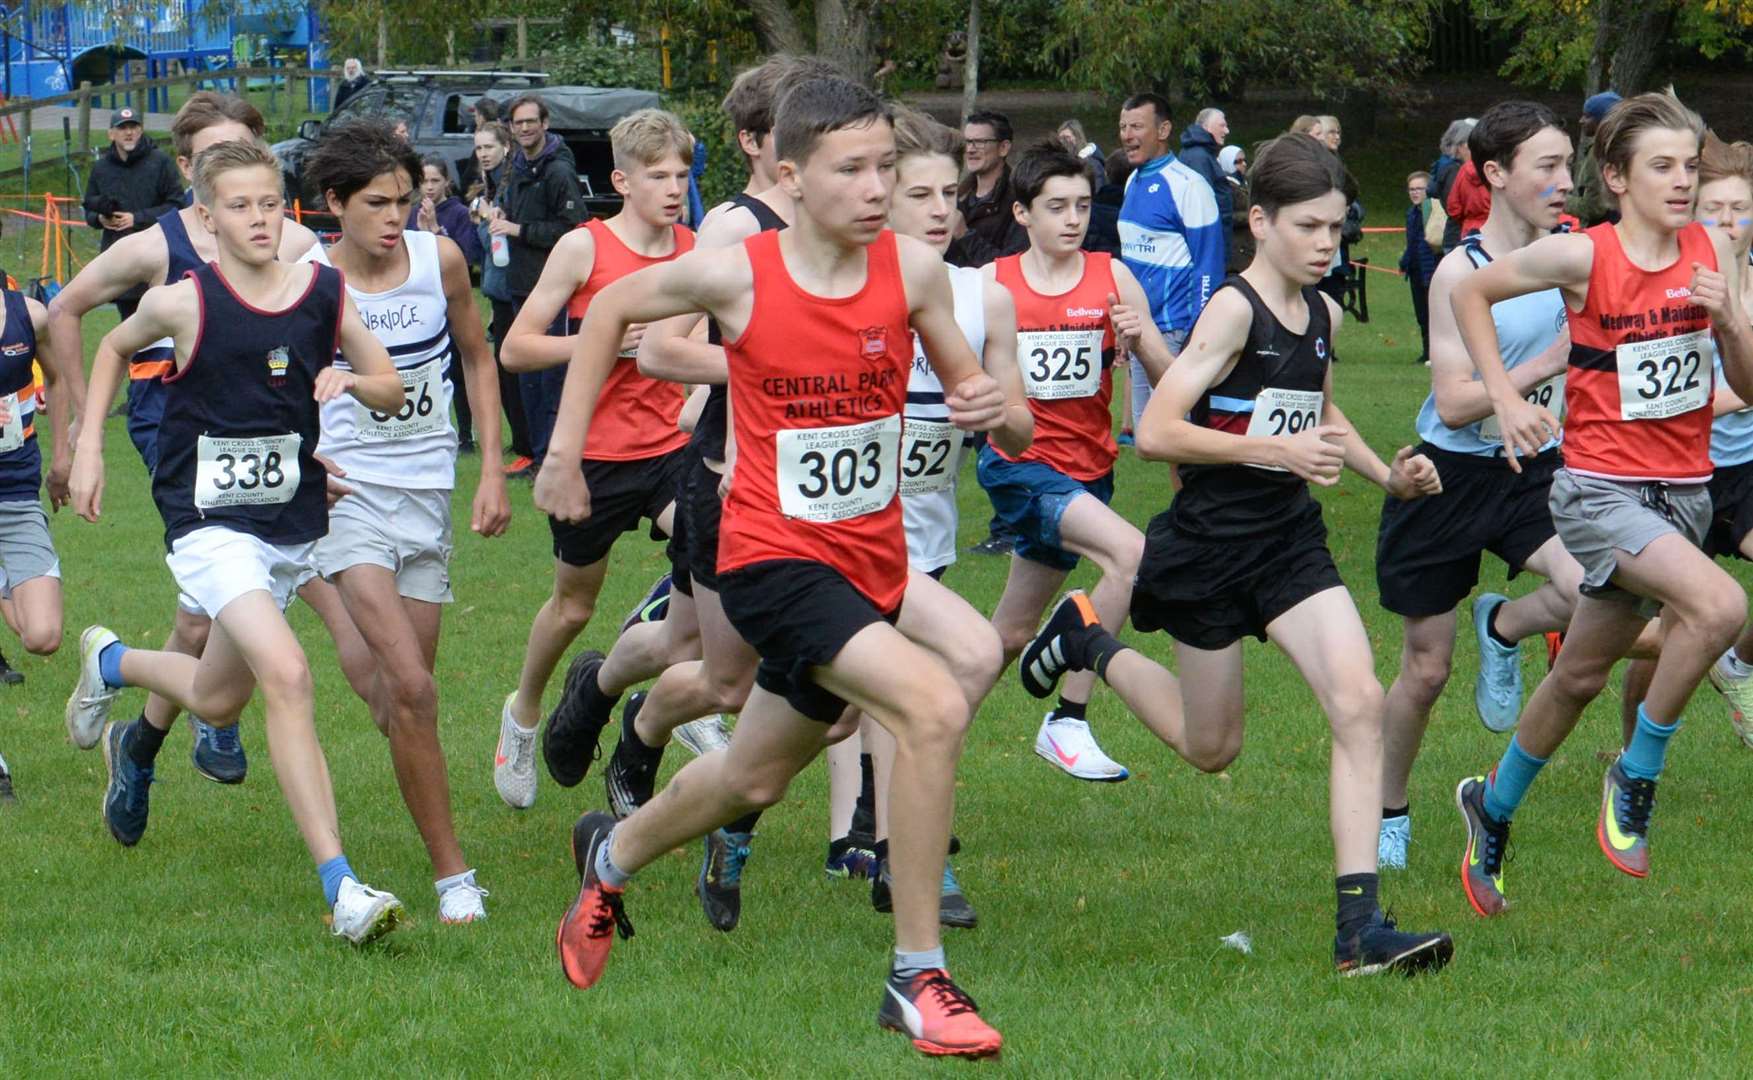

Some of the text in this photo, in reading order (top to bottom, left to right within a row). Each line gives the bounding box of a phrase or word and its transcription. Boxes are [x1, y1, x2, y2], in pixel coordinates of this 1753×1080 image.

[1066, 307, 1103, 318] Bellway
[1600, 313, 1645, 330] Medway
[1649, 309, 1658, 325] &
[1030, 347, 1091, 382] 325
[1637, 350, 1701, 400] 322
[762, 367, 898, 396] CENTRAL PARK
[785, 394, 883, 419] ATHLETICS
[796, 422, 886, 441] KENT CROSS COUNTY
[805, 440, 840, 449] LEAGUE
[213, 451, 285, 491] 338
[798, 441, 881, 499] 303
[902, 439, 951, 478] 52
[808, 497, 863, 511] KENT COUNTY
[831, 501, 881, 519] ASSOCIATION
